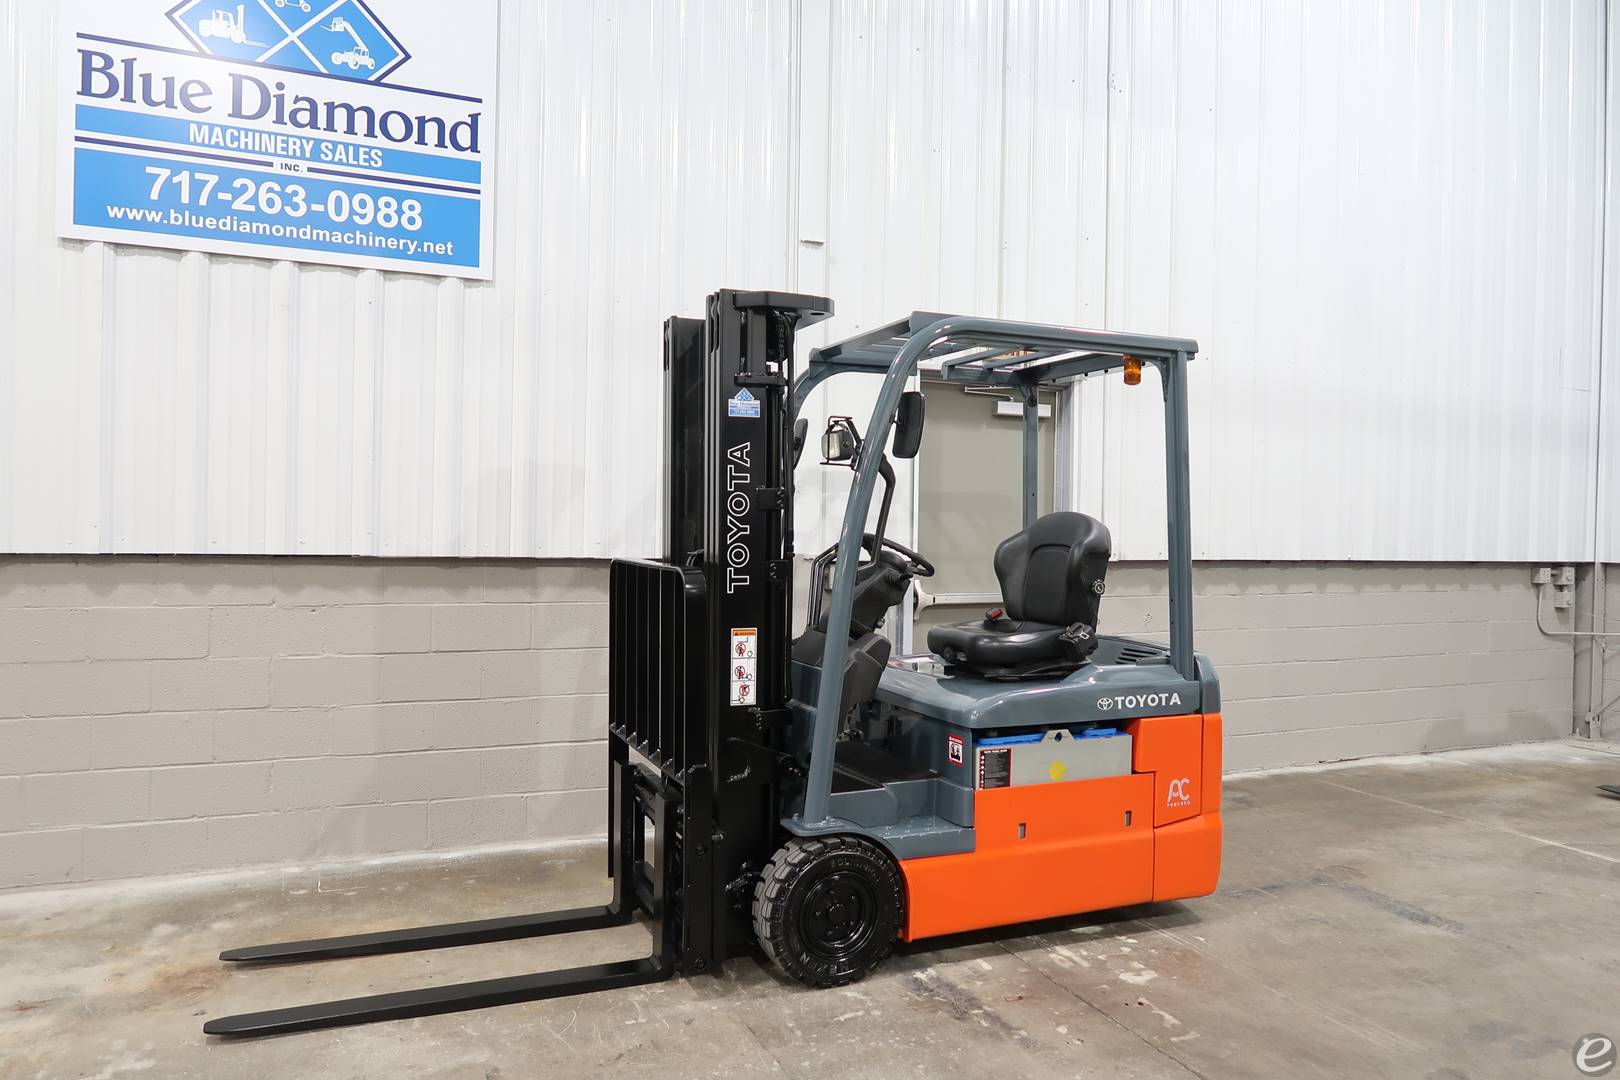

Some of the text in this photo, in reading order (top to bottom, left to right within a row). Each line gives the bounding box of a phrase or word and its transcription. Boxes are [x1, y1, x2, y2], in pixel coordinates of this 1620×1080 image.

[76, 48, 481, 154] Blue Diamond
[188, 124, 383, 169] MACHINERY SALES
[279, 162, 304, 173] INC.
[145, 165, 423, 231] 717-263-0988
[106, 204, 454, 256] www.bluediamondmachinery.net
[727, 441, 750, 594] TOYOTA
[1114, 692, 1182, 709] TOYOTA
